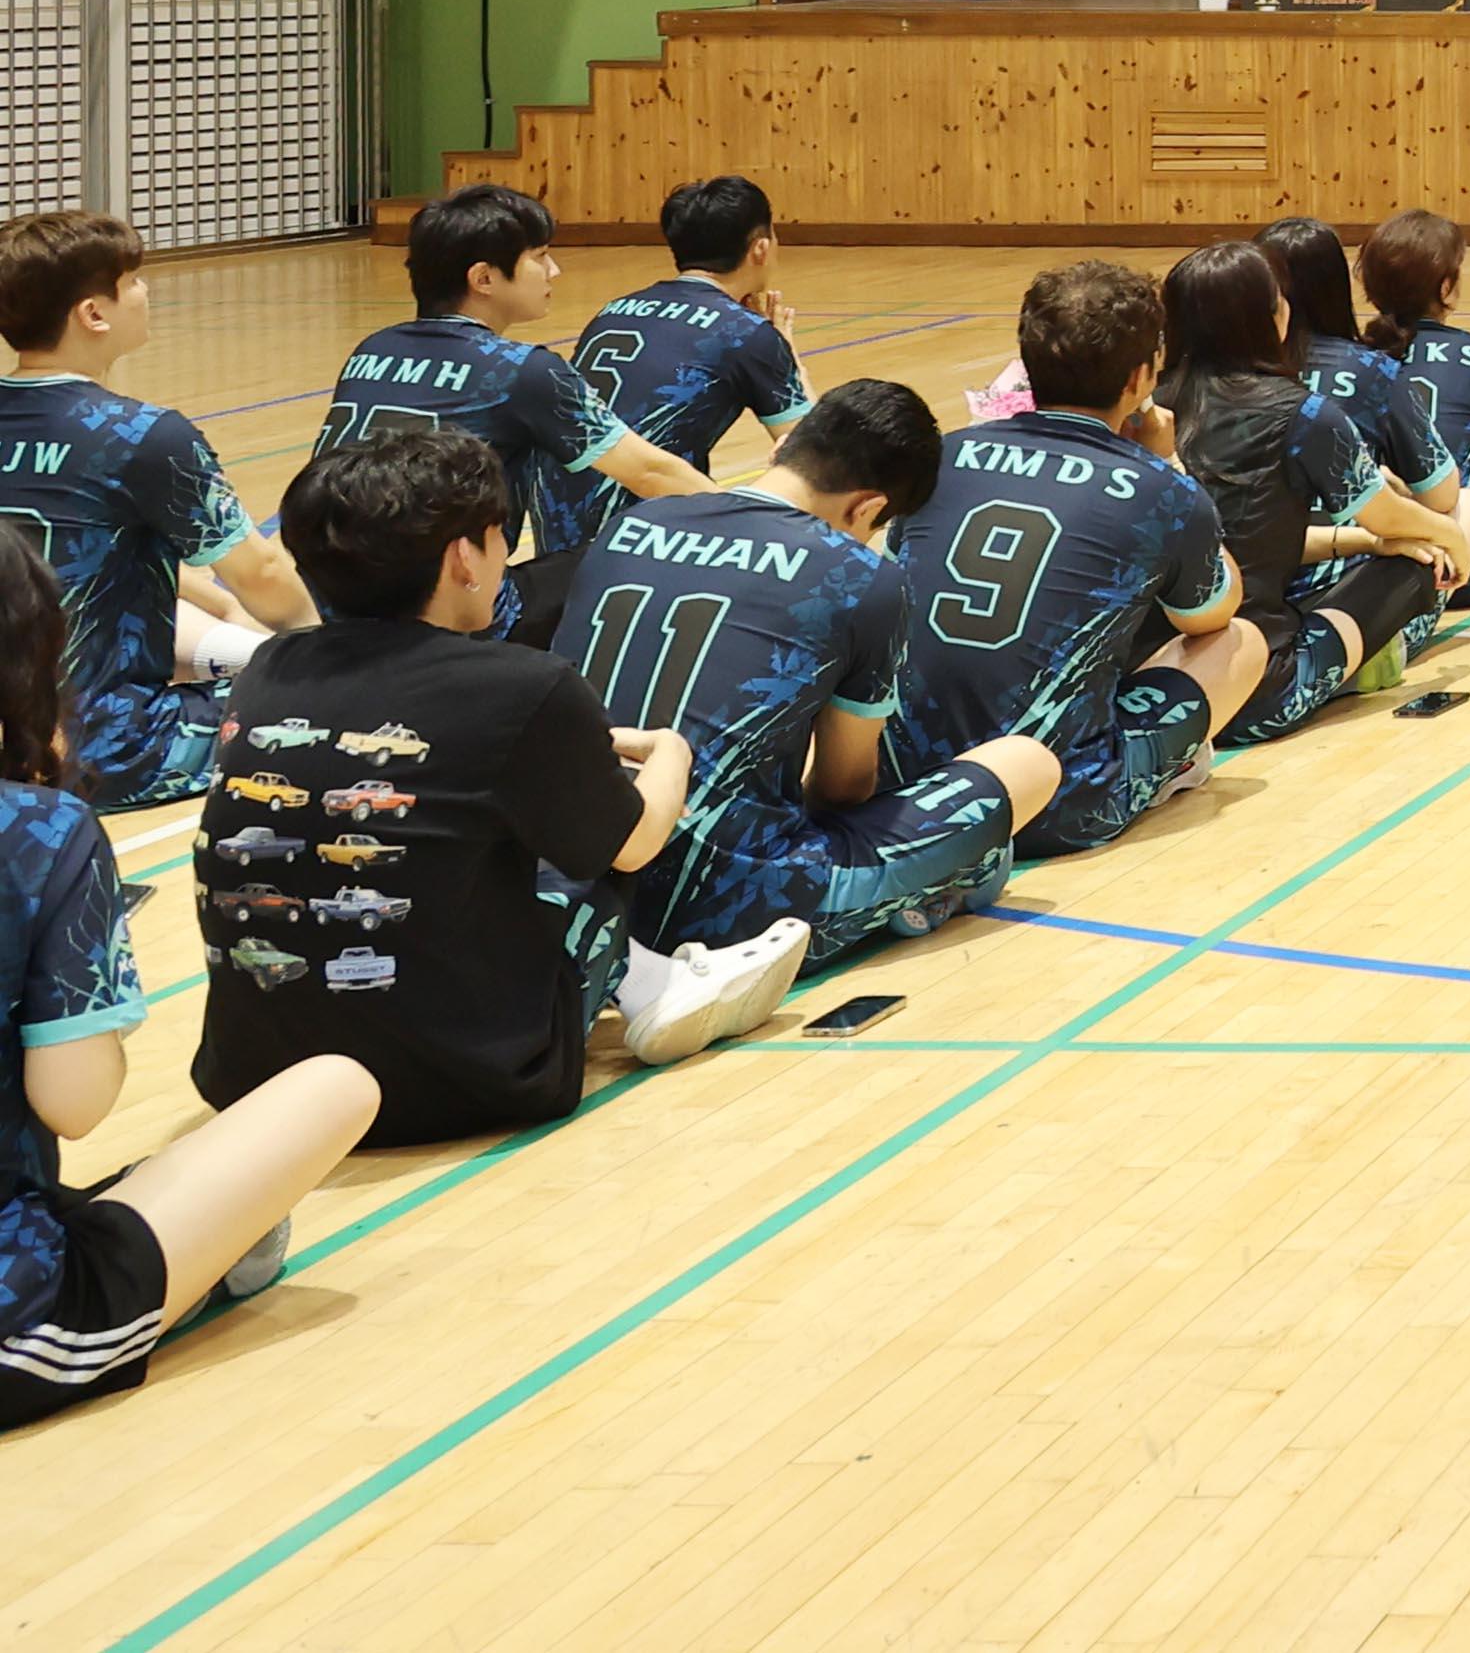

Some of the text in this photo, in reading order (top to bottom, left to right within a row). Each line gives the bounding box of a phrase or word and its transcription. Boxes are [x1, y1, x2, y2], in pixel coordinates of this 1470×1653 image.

[659, 303, 686, 322] H
[687, 307, 722, 329] H
[392, 358, 431, 384] M
[433, 361, 473, 392] H
[1331, 371, 1358, 397] S
[34, 441, 72, 474] W
[953, 439, 1141, 501] KIM D S
[607, 514, 810, 584] ENHAN
[928, 499, 1063, 651] 9
[582, 583, 732, 731] 11
